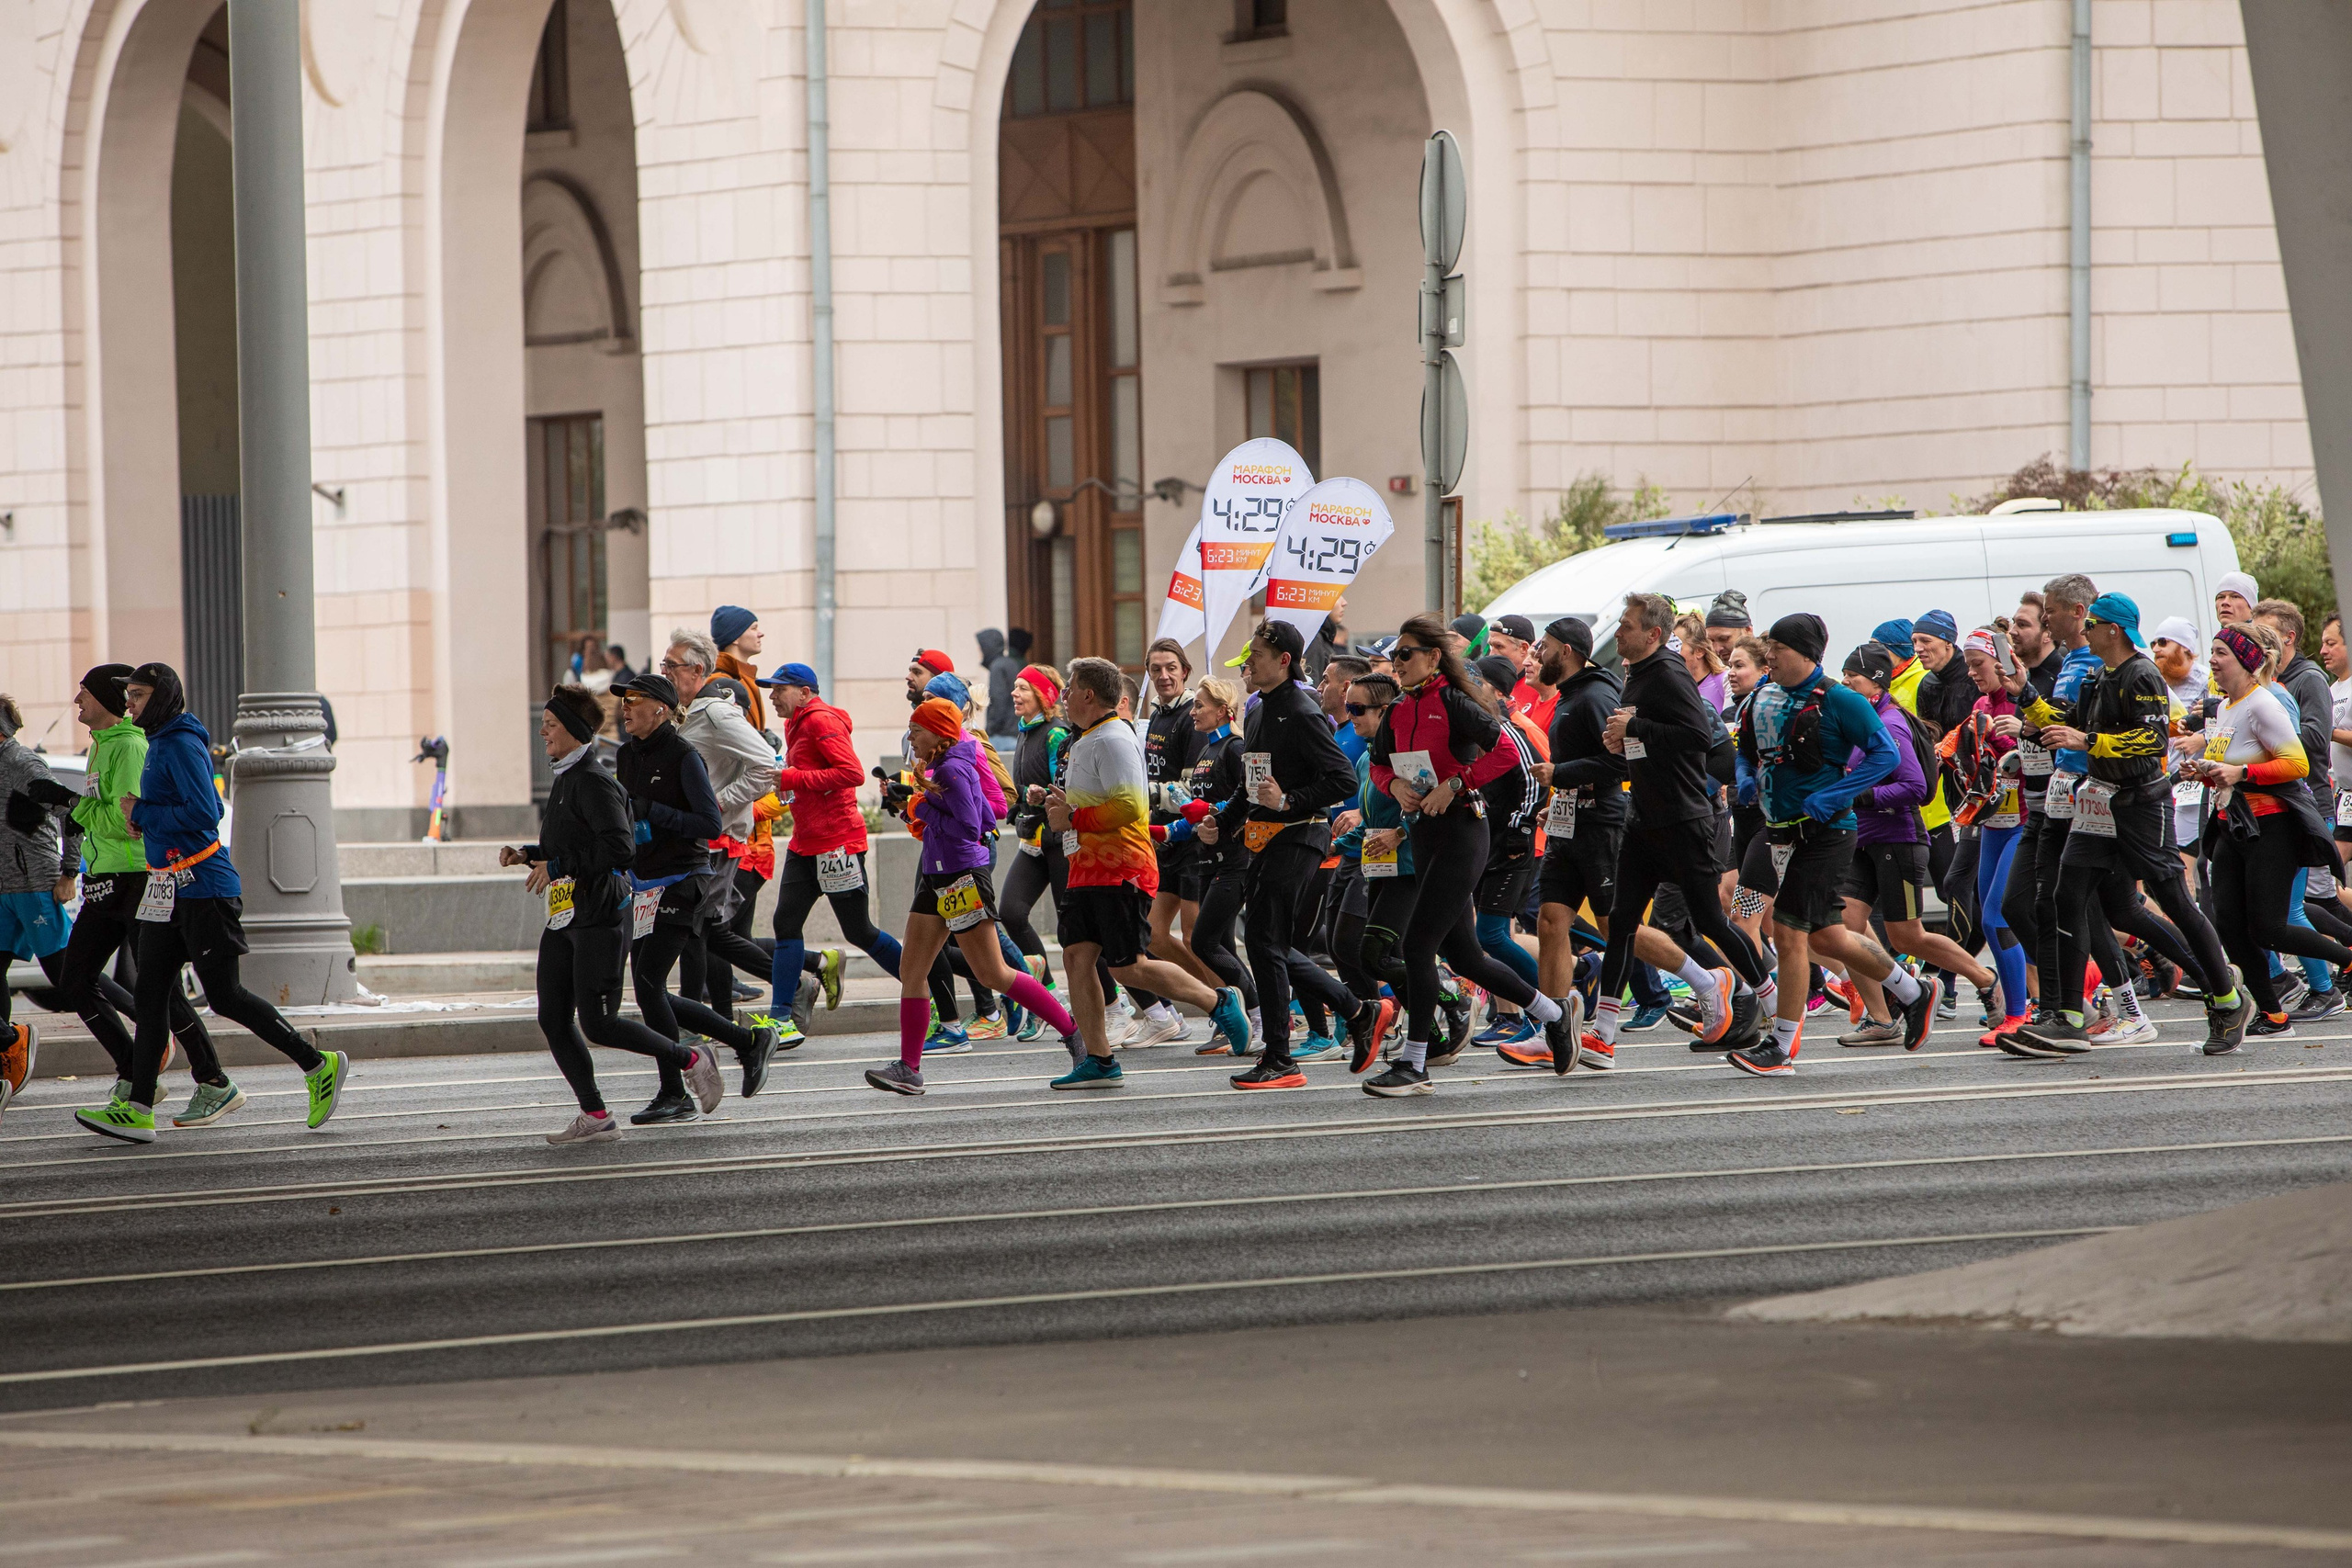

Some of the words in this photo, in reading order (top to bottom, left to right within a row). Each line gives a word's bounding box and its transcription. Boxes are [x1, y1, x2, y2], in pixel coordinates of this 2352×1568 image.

[1233, 465, 1292, 476] МАРАФОН
[1232, 474, 1282, 485] МОСКВА
[1213, 497, 1283, 532] 4:29
[1310, 502, 1373, 517] МАРАФОН
[1309, 512, 1361, 526] МОСКВА
[1206, 548, 1235, 563] 6:23
[1287, 535, 1362, 574] 4:29
[1172, 580, 1202, 603] 6:23
[1276, 586, 1306, 603] 6:23
[1308, 595, 1320, 604] КМ
[2049, 780, 2070, 796] 6704
[2078, 797, 2112, 818] 17304
[820, 855, 854, 874] 2414
[944, 891, 967, 912] 891
